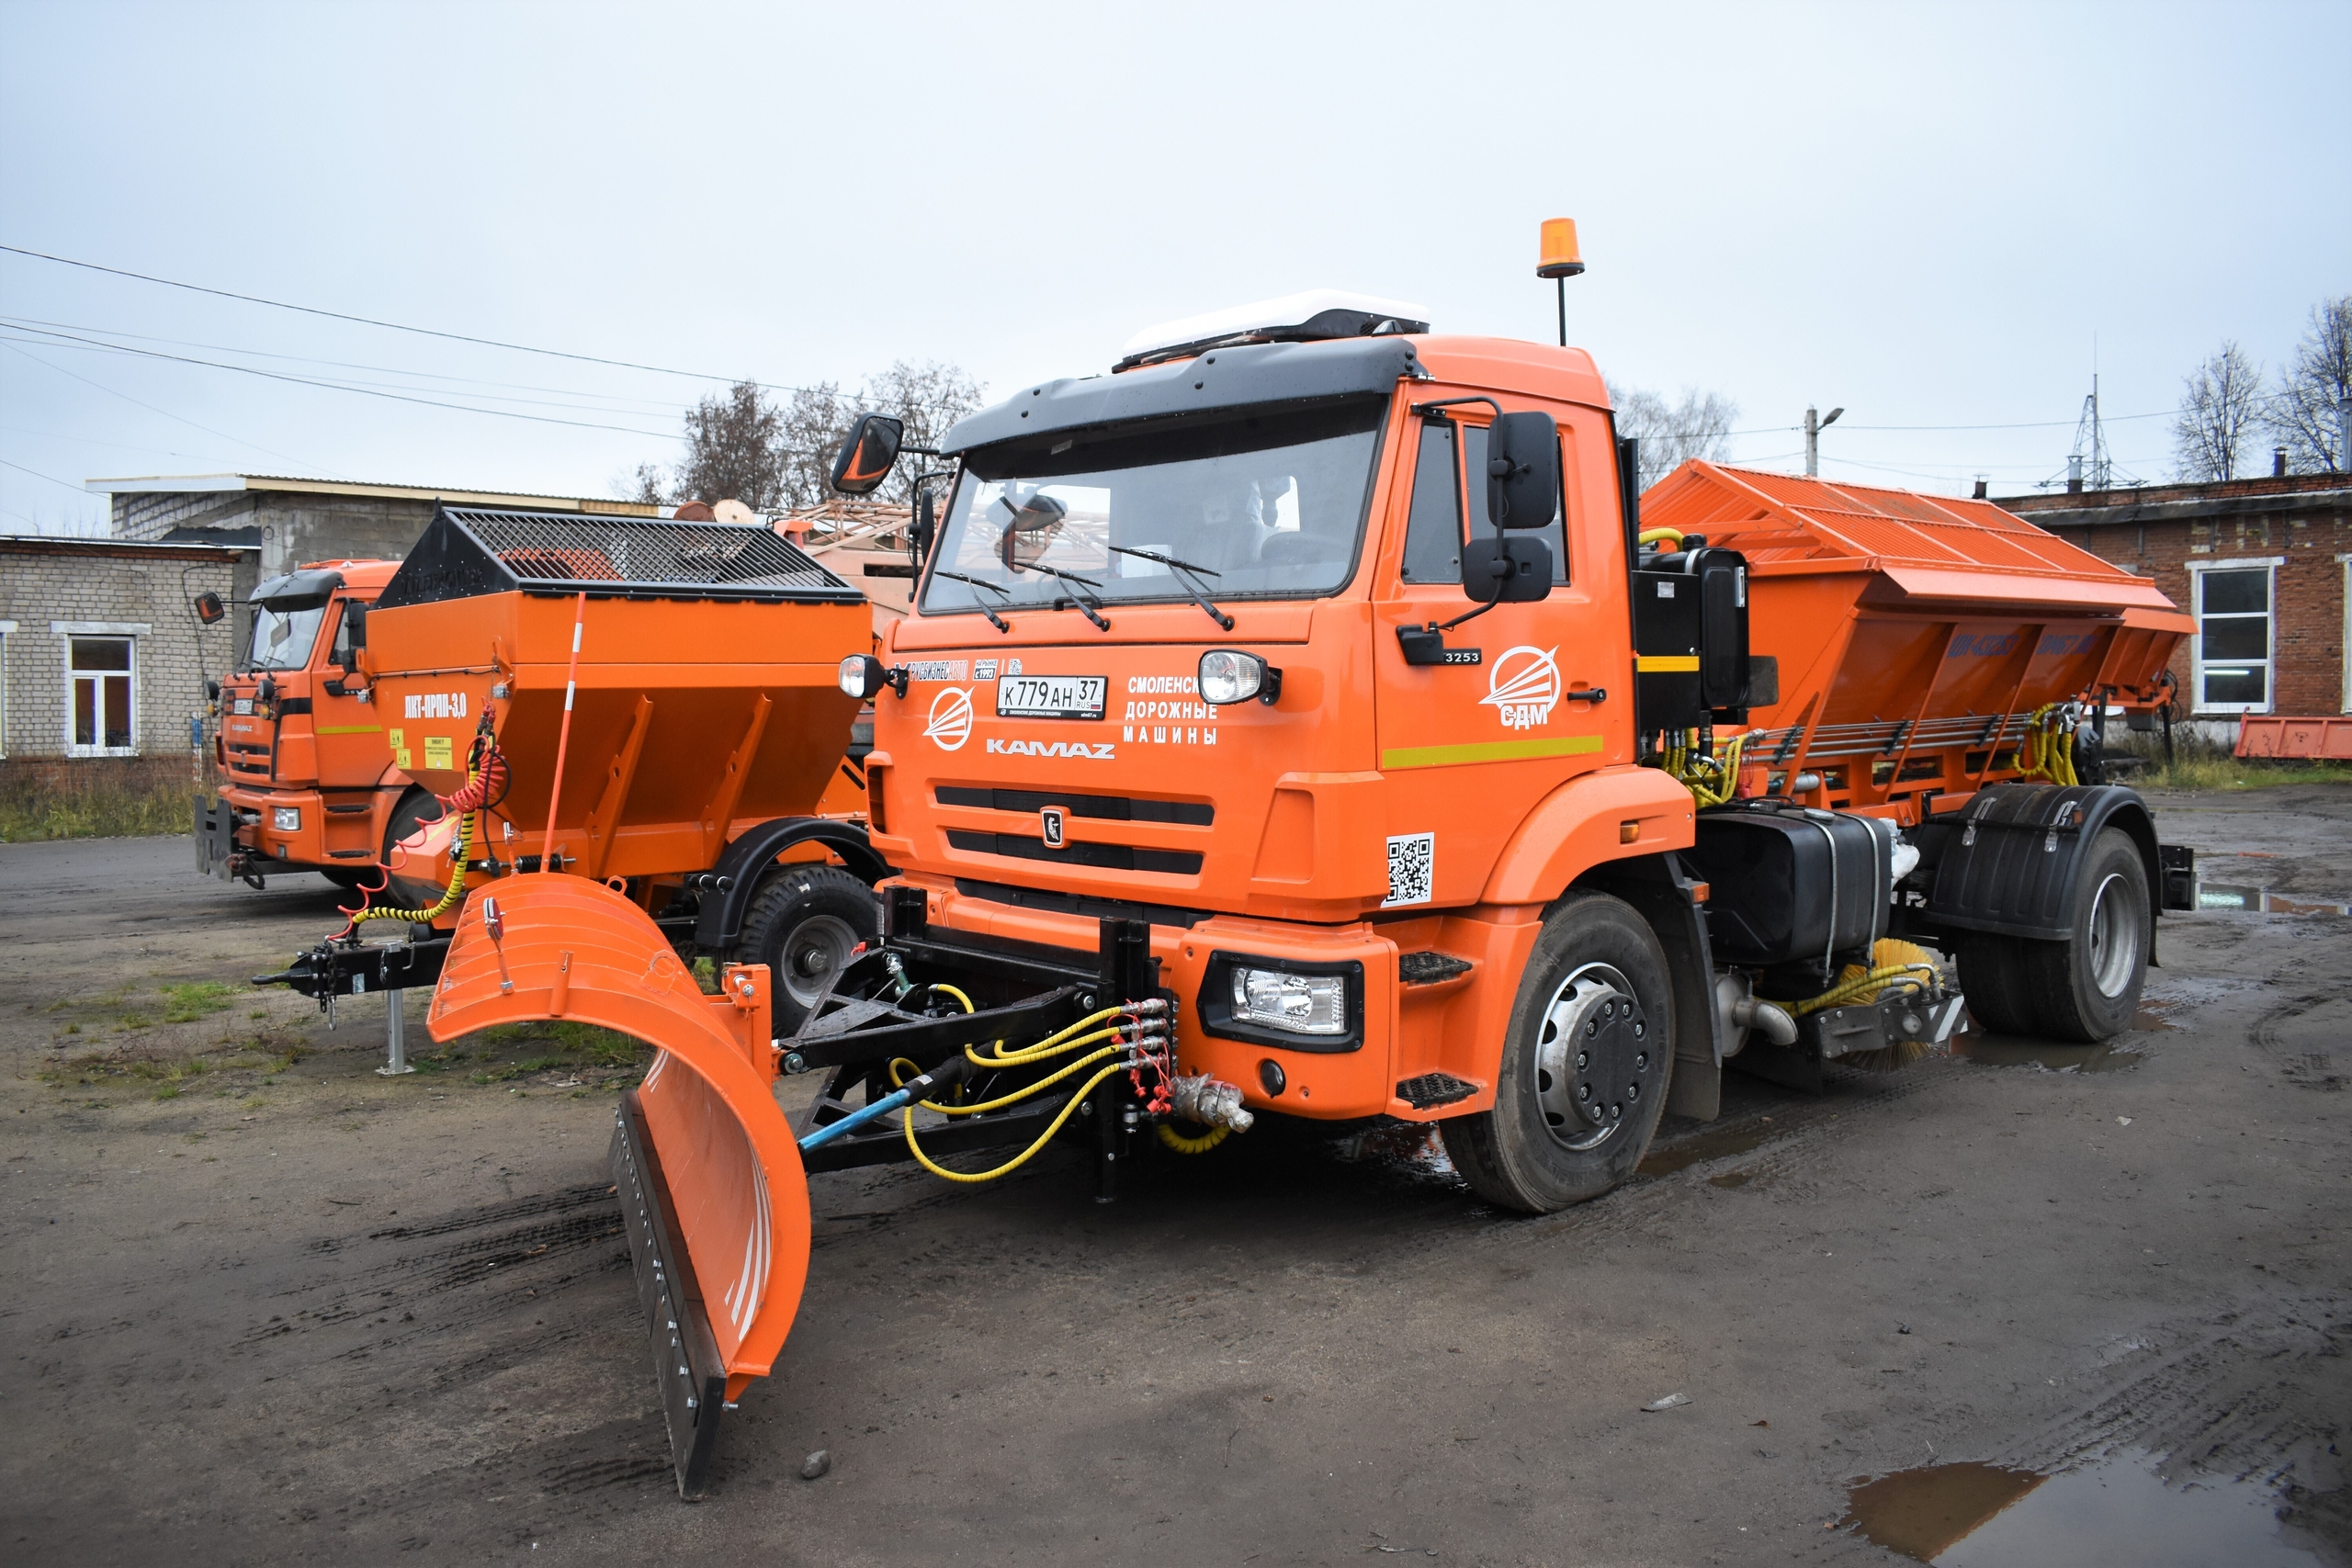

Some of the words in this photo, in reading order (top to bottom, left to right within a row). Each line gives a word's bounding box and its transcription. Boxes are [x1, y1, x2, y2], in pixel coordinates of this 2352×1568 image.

[1445, 652, 1479, 662] 3253
[1079, 680, 1099, 701] 37
[1127, 676, 1200, 694] СМОЛЕНСК
[1076, 701, 1091, 709] RUS
[1125, 701, 1218, 721] ДОРОЖНЫЕ
[1500, 704, 1548, 730] СДМ
[1123, 725, 1217, 745] МАШИНЫ
[986, 739, 1115, 760] KAMAZ
